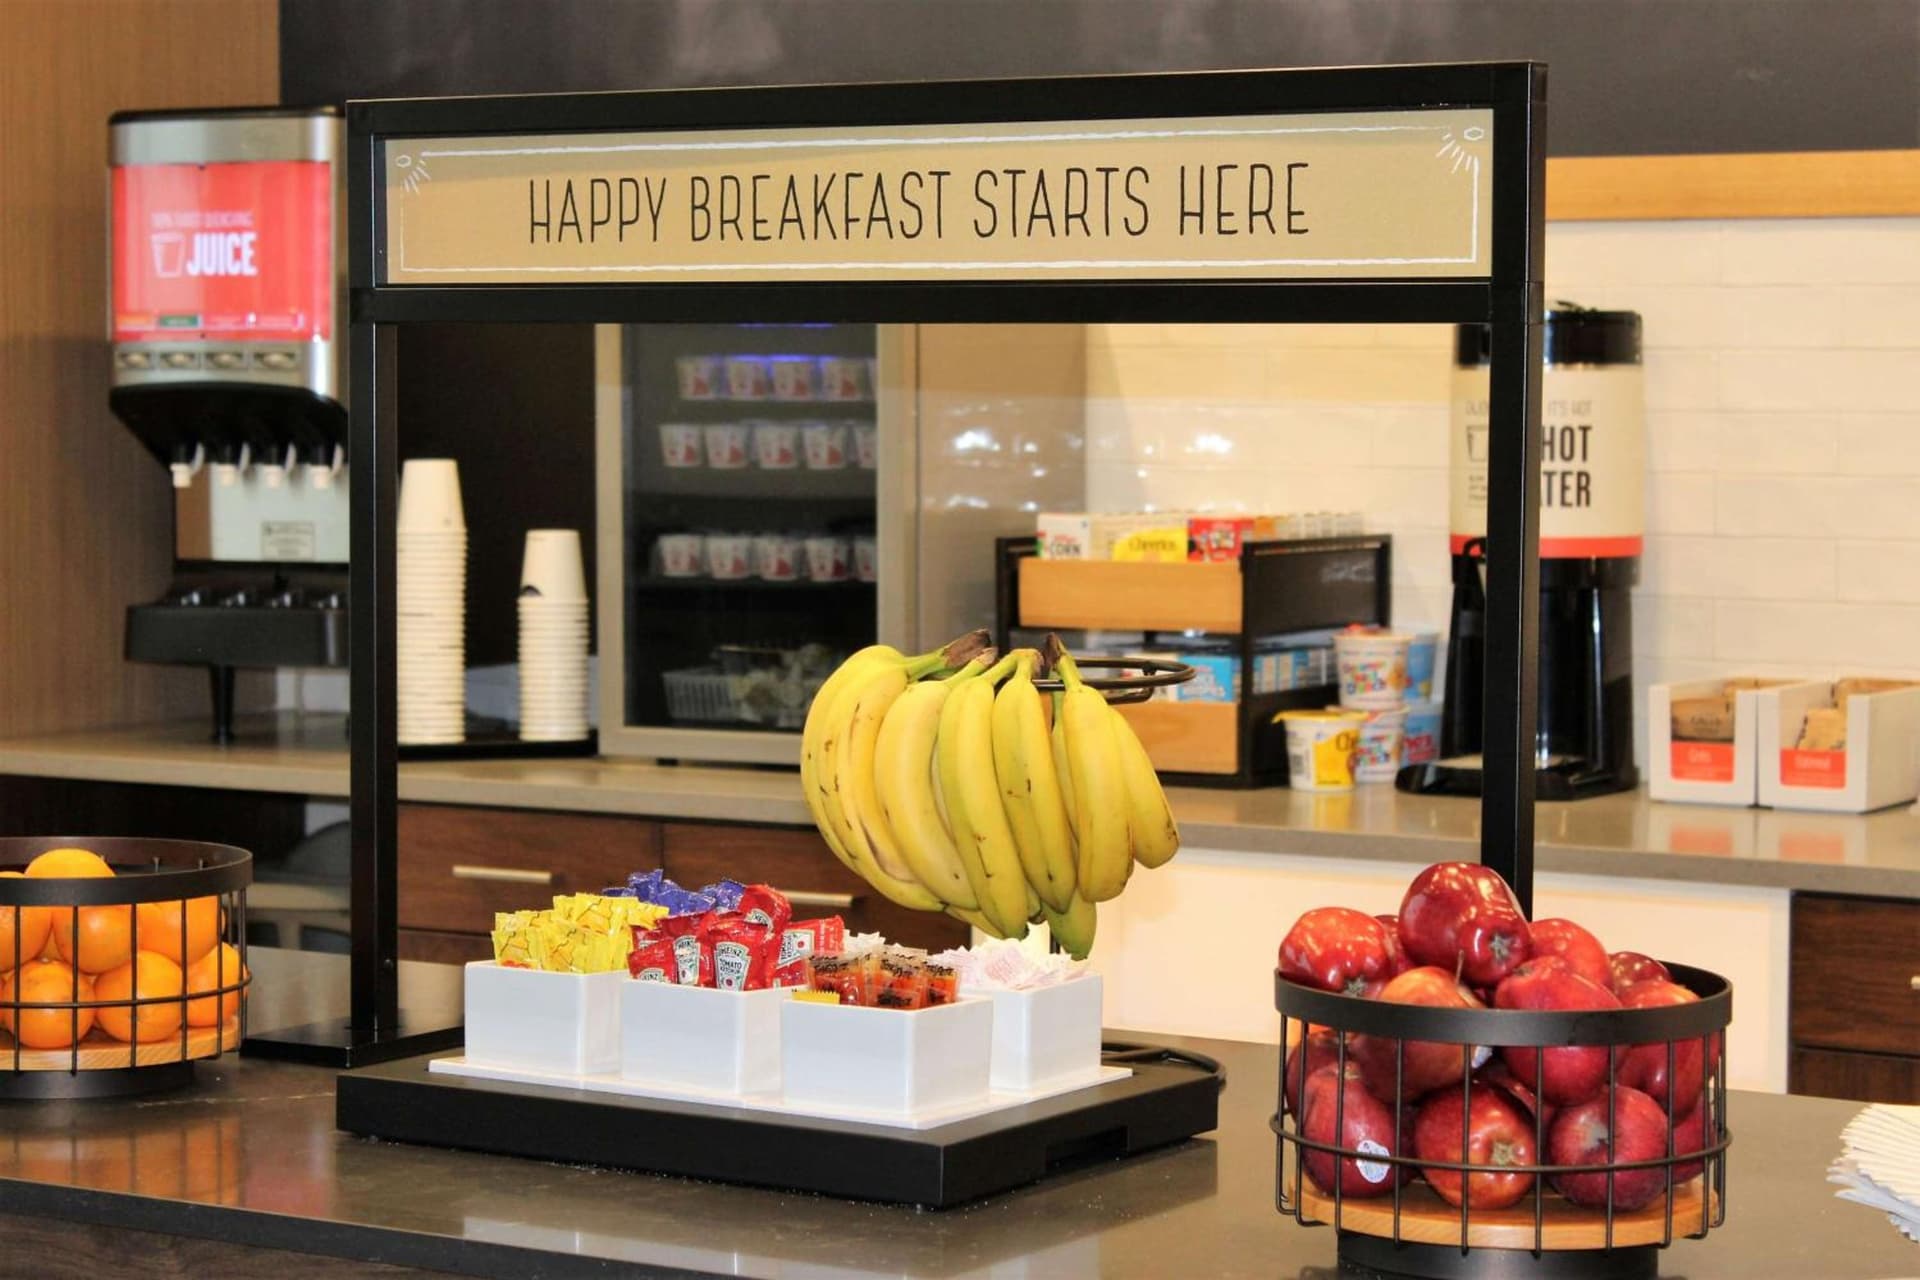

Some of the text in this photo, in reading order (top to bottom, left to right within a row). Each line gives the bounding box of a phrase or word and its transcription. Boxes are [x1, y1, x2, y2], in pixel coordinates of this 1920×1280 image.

[530, 163, 1309, 244] HAPPY BREAKFAST STARTS HERE
[186, 232, 258, 276] JUICE
[1542, 425, 1592, 463] HOT
[1541, 471, 1591, 508] TER
[719, 958, 743, 970] TOMATO
[720, 946, 742, 957] HEINZ
